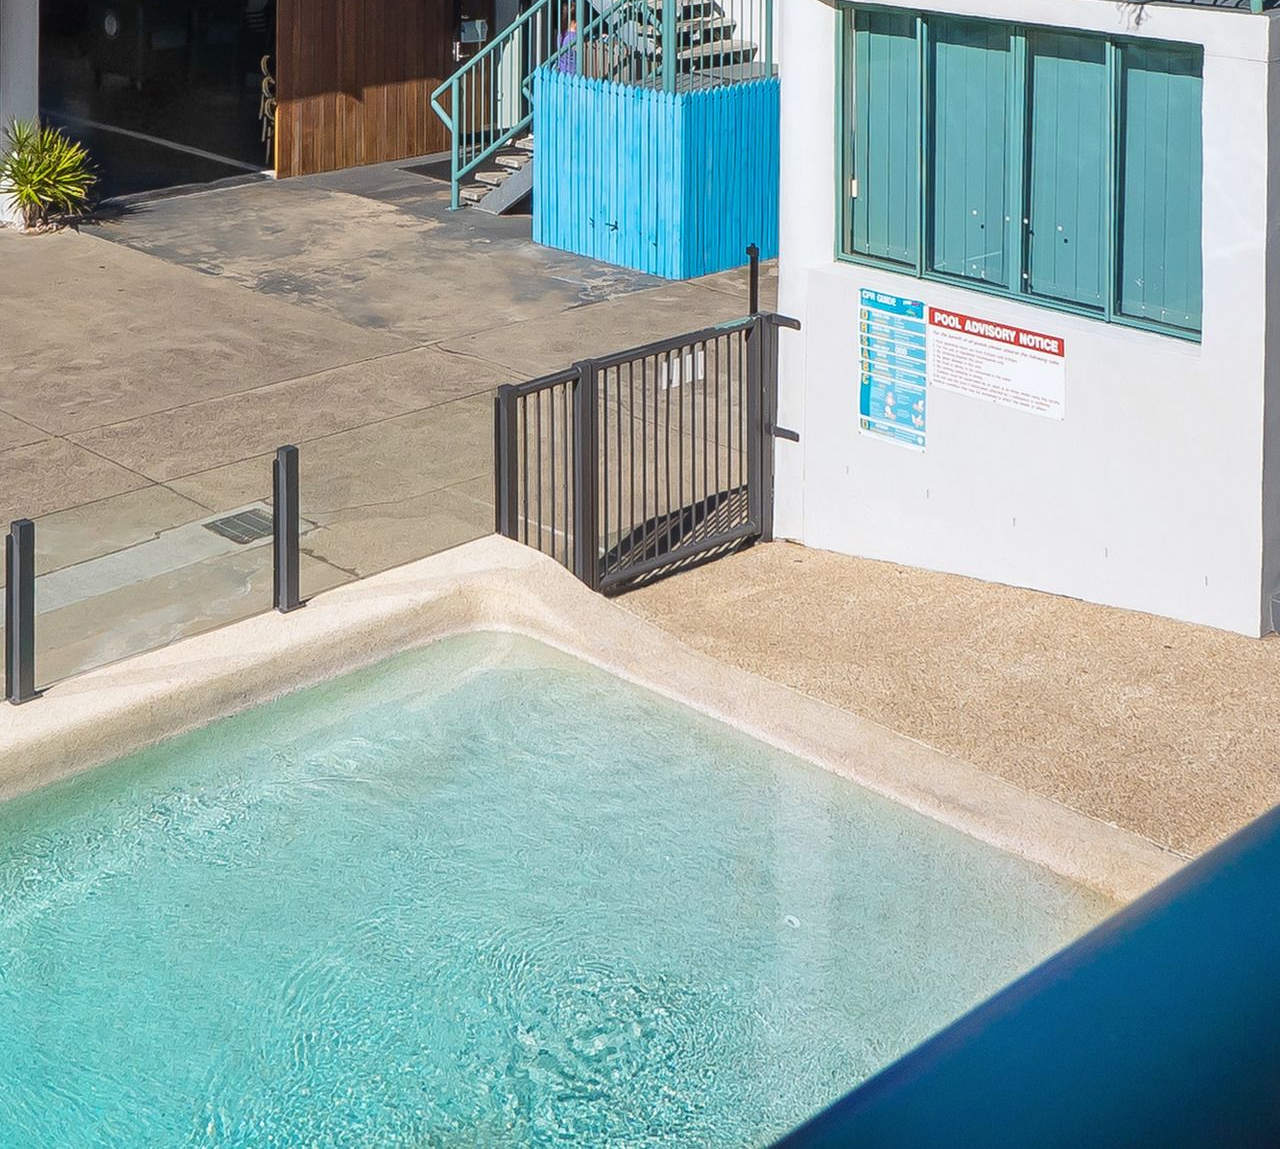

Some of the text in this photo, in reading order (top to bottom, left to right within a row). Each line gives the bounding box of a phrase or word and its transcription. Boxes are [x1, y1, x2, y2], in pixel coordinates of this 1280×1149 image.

[862, 290, 876, 301] CPR
[934, 311, 962, 329] POOL
[964, 319, 1017, 343] ADVISORY
[1019, 332, 1059, 353] NOTICE
